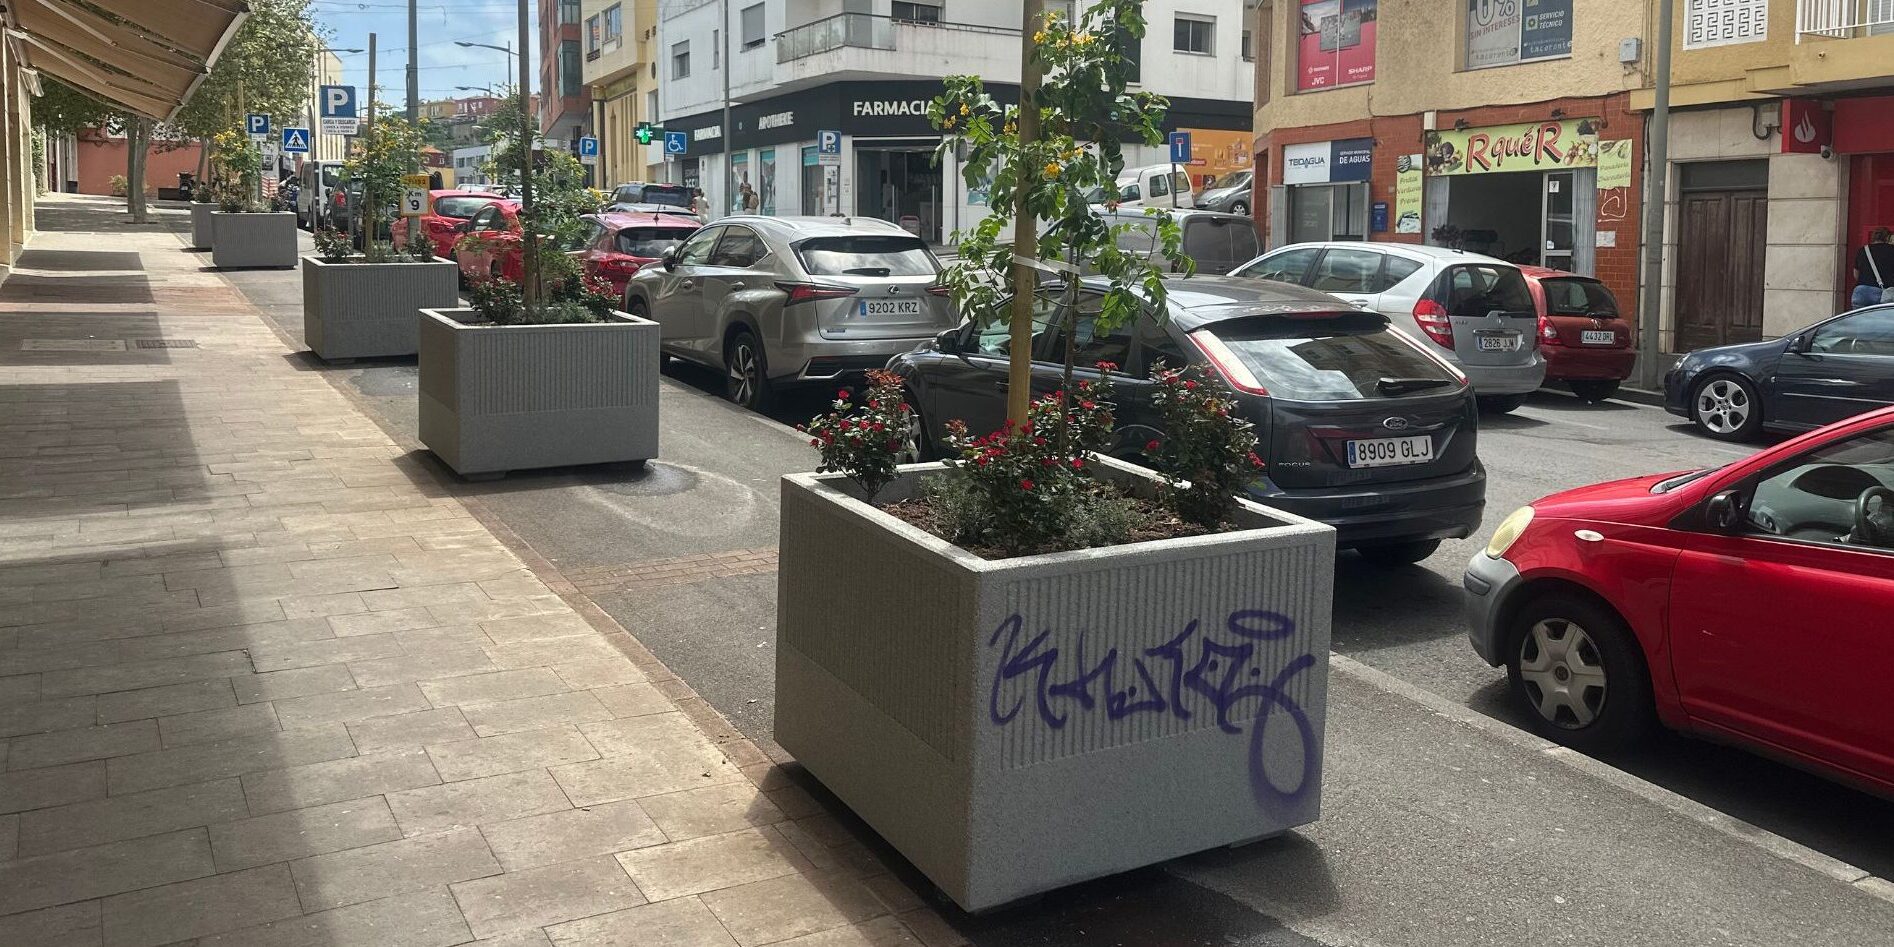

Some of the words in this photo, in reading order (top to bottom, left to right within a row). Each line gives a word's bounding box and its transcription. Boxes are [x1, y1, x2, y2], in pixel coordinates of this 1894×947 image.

[1539, 10, 1565, 21] SERVICIO
[1470, 29, 1482, 40] SIN
[1482, 15, 1521, 34] INTERESES
[1539, 20, 1563, 30] TÉCNICO
[1348, 65, 1373, 75] SHARP
[1311, 76, 1325, 86] JVC
[328, 88, 349, 115] P
[252, 116, 264, 132] P
[694, 125, 722, 141] FARMACIA
[758, 111, 794, 130] APOTHEKE
[585, 140, 594, 153] P
[823, 132, 836, 150] P
[1340, 156, 1348, 164] DE
[1349, 155, 1370, 164] AGUAS
[411, 199, 420, 211] 9
[869, 302, 895, 314] 9202
[898, 302, 918, 313] KRZ
[1484, 338, 1501, 348] 2826
[1358, 442, 1396, 461] 8909
[1401, 439, 1429, 458] GLJ
